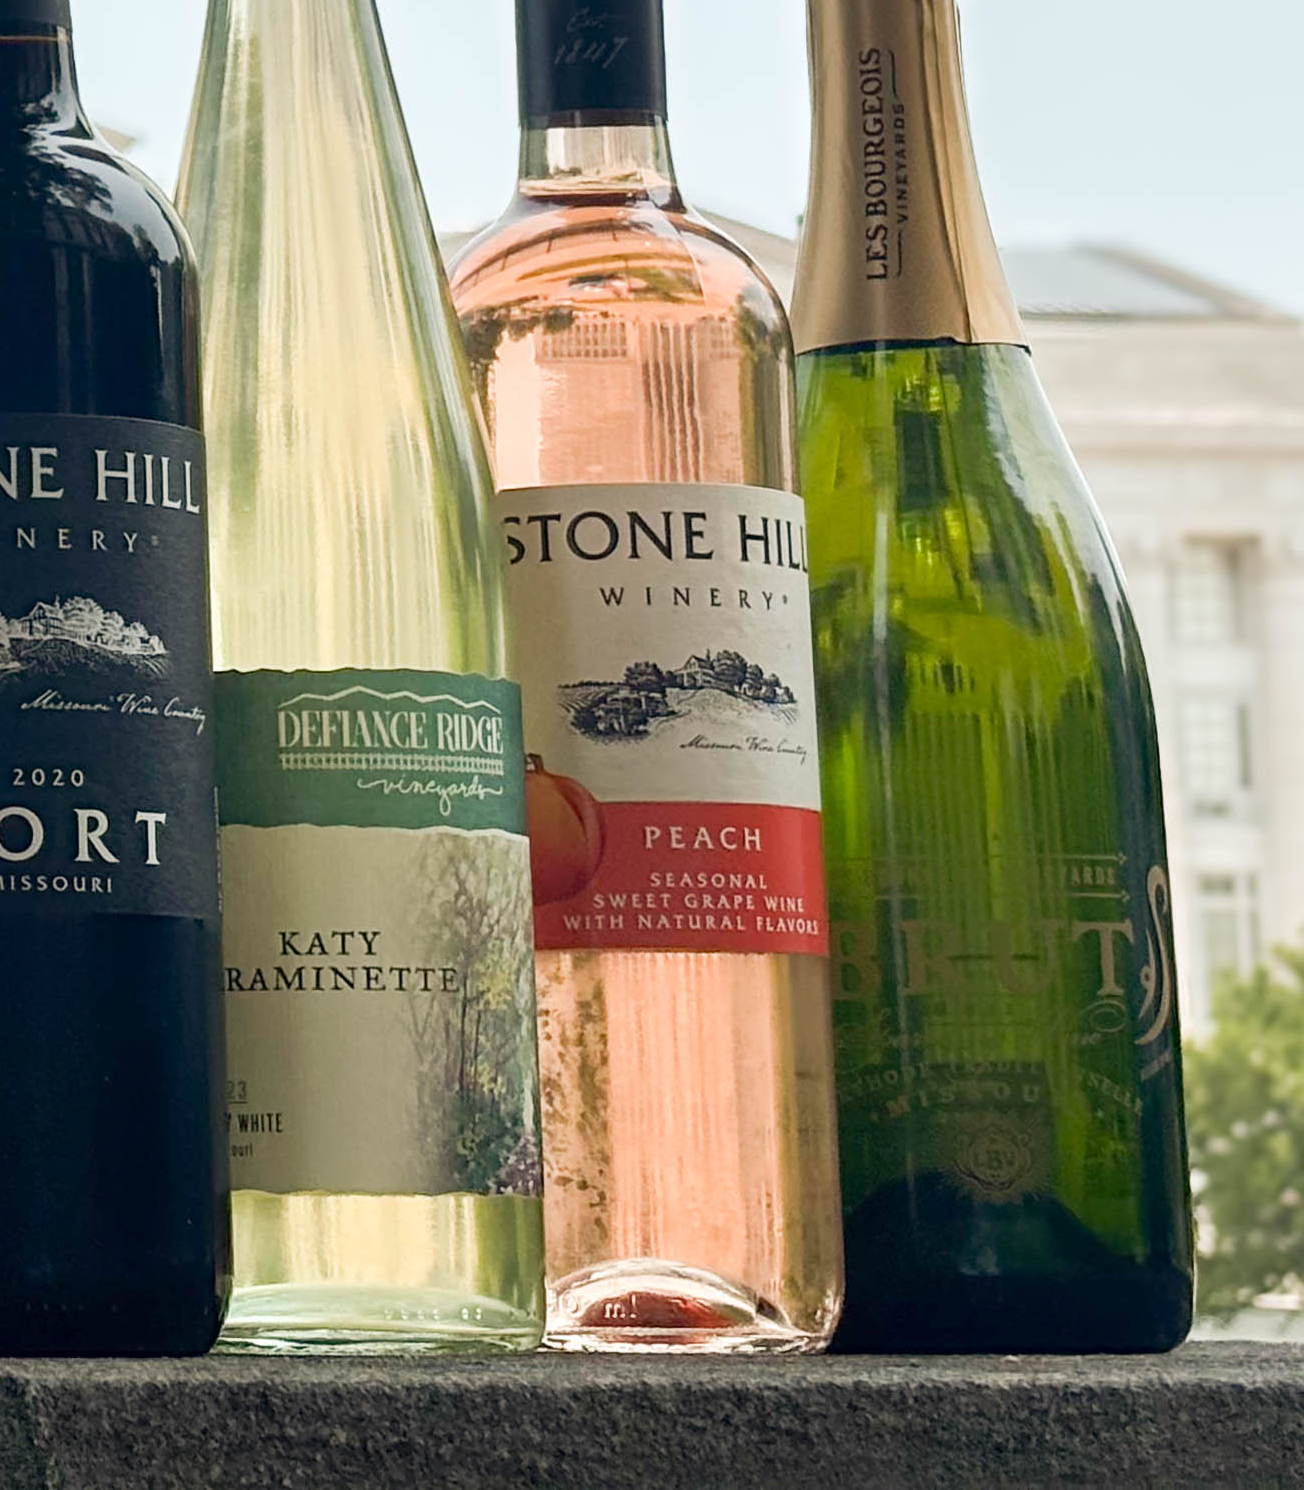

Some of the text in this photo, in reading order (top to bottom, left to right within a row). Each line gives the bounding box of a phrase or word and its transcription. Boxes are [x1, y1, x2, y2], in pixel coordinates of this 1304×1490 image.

[554, 36, 629, 69] 1847
[858, 46, 889, 281] LES BOURGEOIS
[894, 103, 908, 226] VINEYARDS
[94, 449, 200, 514] HILL
[116, 692, 159, 716] Wine
[278, 710, 504, 754] DEFIANCE RIDGE
[12, 768, 85, 787] 2020
[358, 775, 503, 816] vineyards
[644, 826, 762, 851] PEACH
[650, 872, 768, 890] SEASONAL
[593, 893, 804, 914] SWEET GRAPE WINE
[563, 914, 819, 936] WITH NATURAL FLAVORS
[278, 931, 381, 957] KATY
[224, 966, 460, 992] RAMINETTE
[237, 1113, 284, 1133] WHITE
